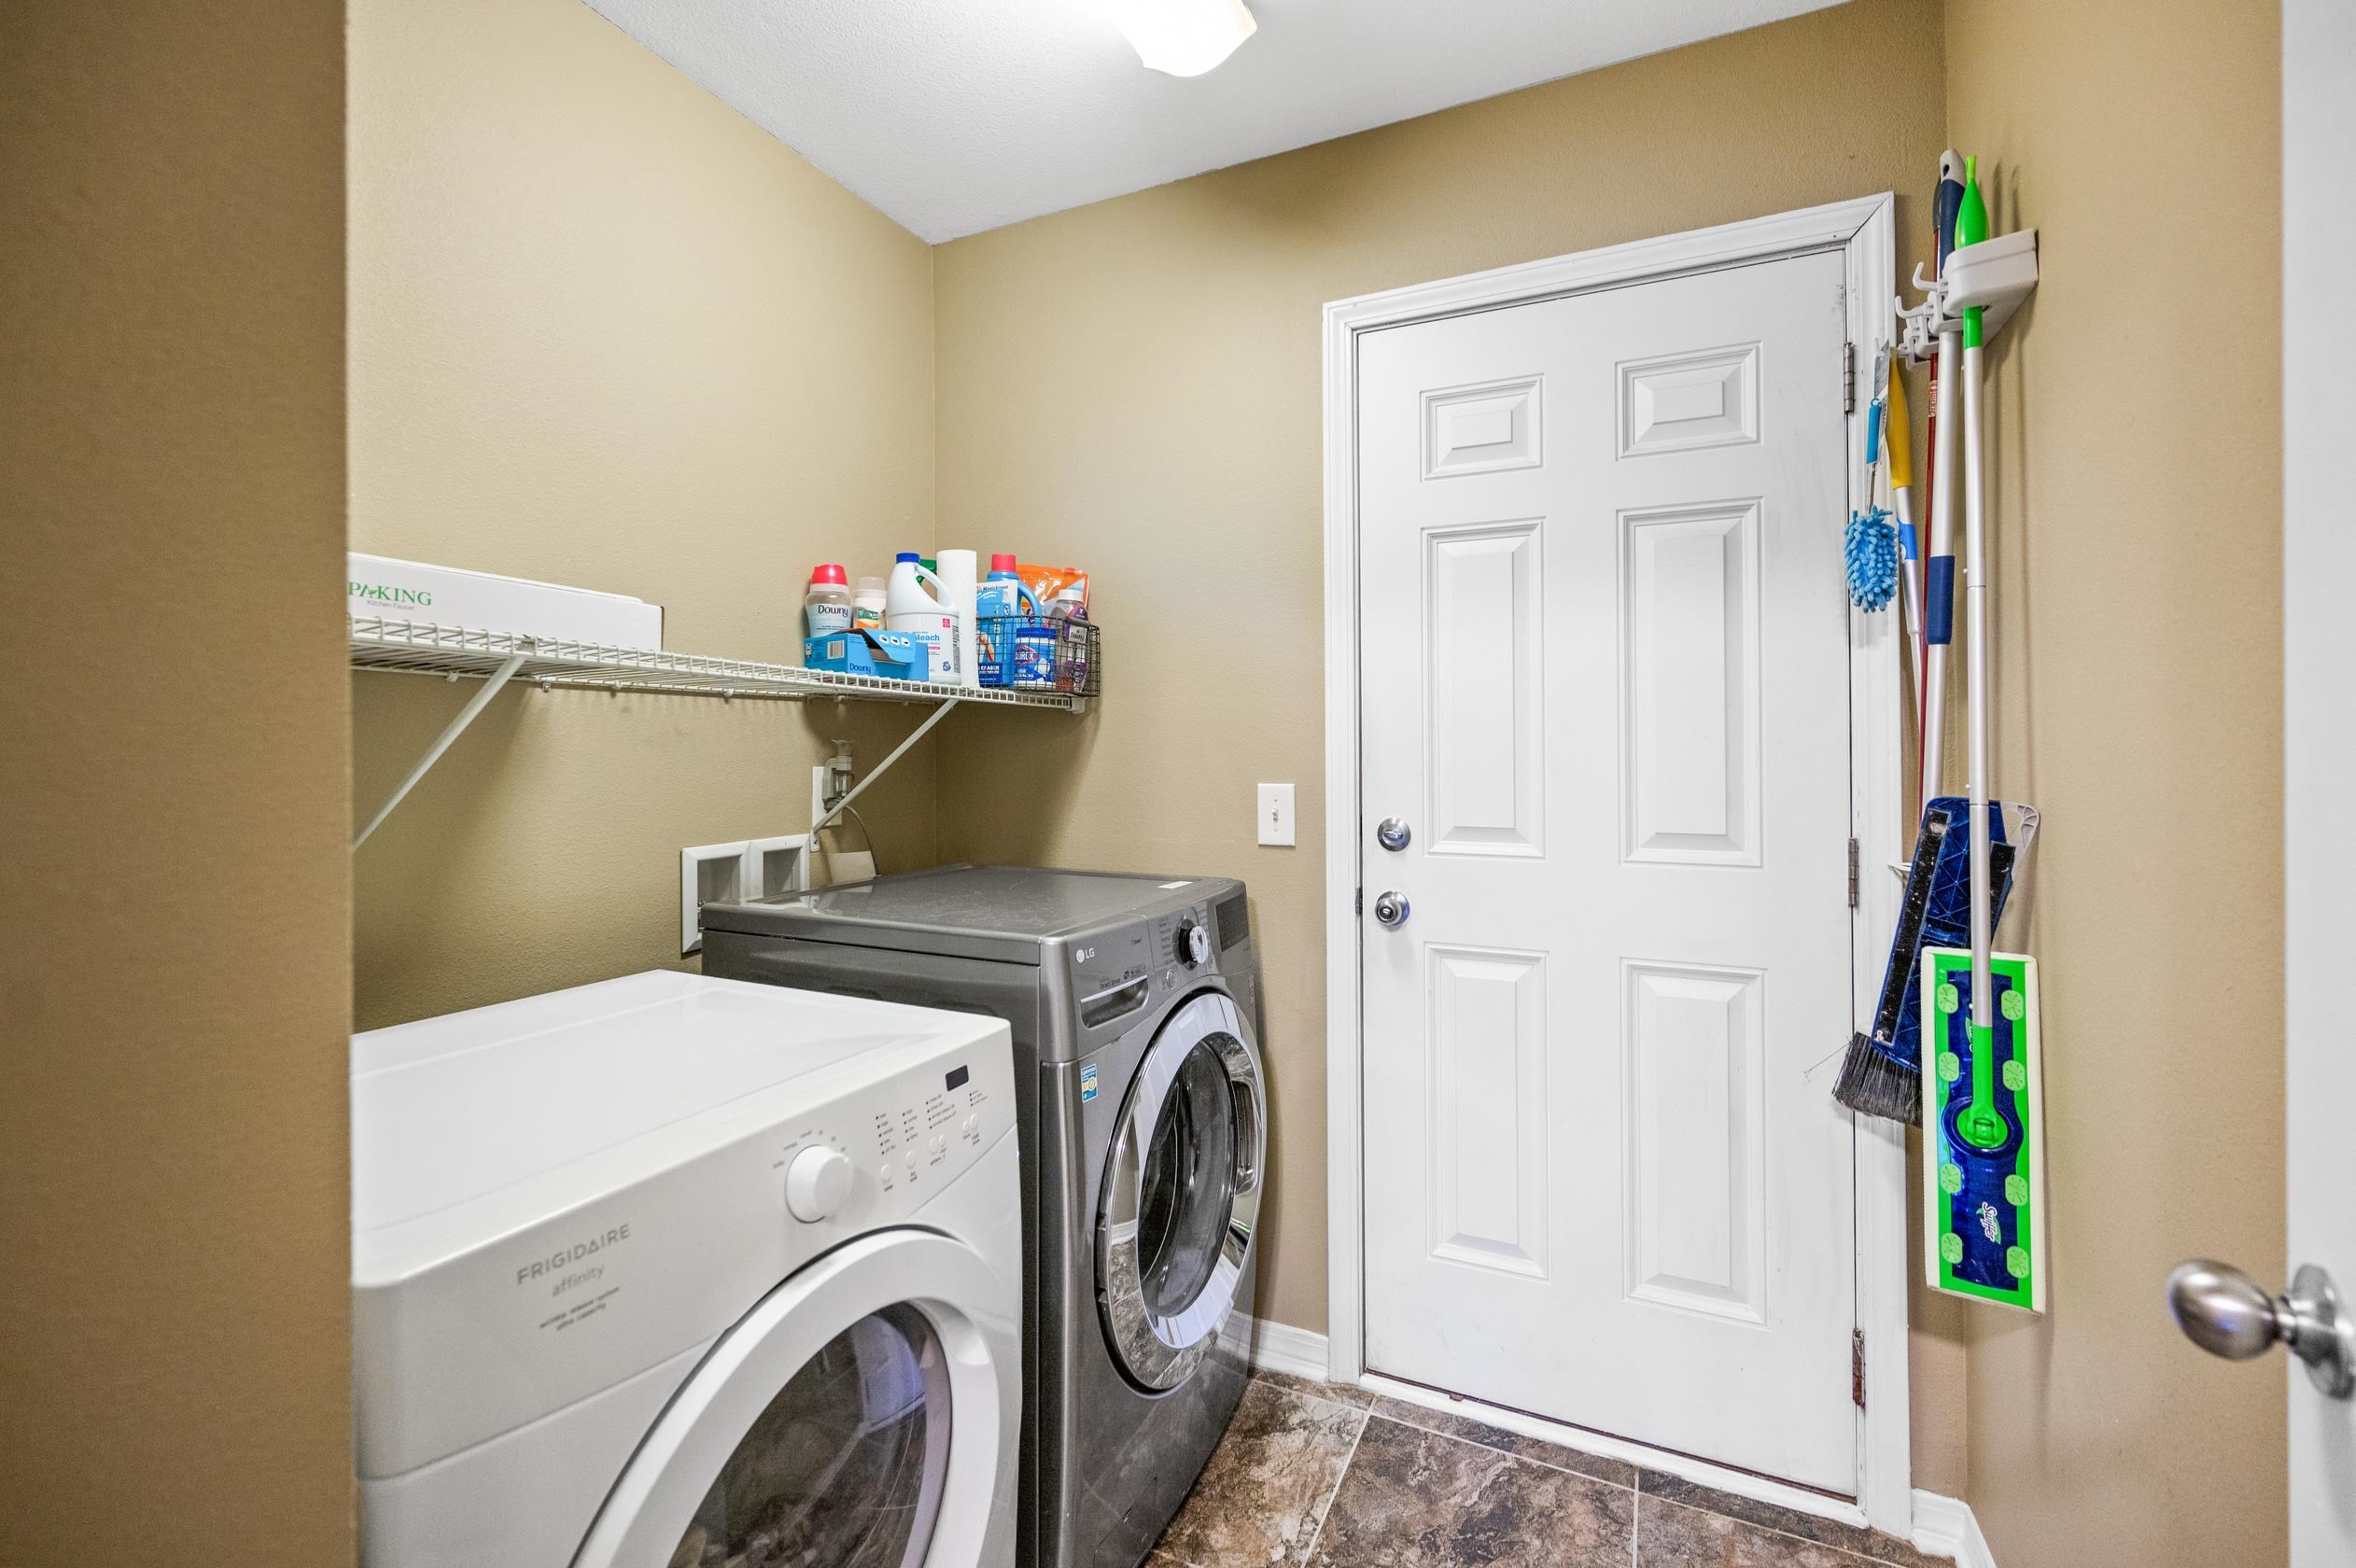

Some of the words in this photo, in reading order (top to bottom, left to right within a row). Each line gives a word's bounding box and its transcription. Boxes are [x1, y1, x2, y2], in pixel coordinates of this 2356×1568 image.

[819, 604, 848, 618] Downy
[849, 663, 872, 674] Downy
[1086, 947, 1095, 959] LG
[1980, 1201, 1998, 1242] Swiffer
[516, 1224, 630, 1284] FRIGIDAIRE
